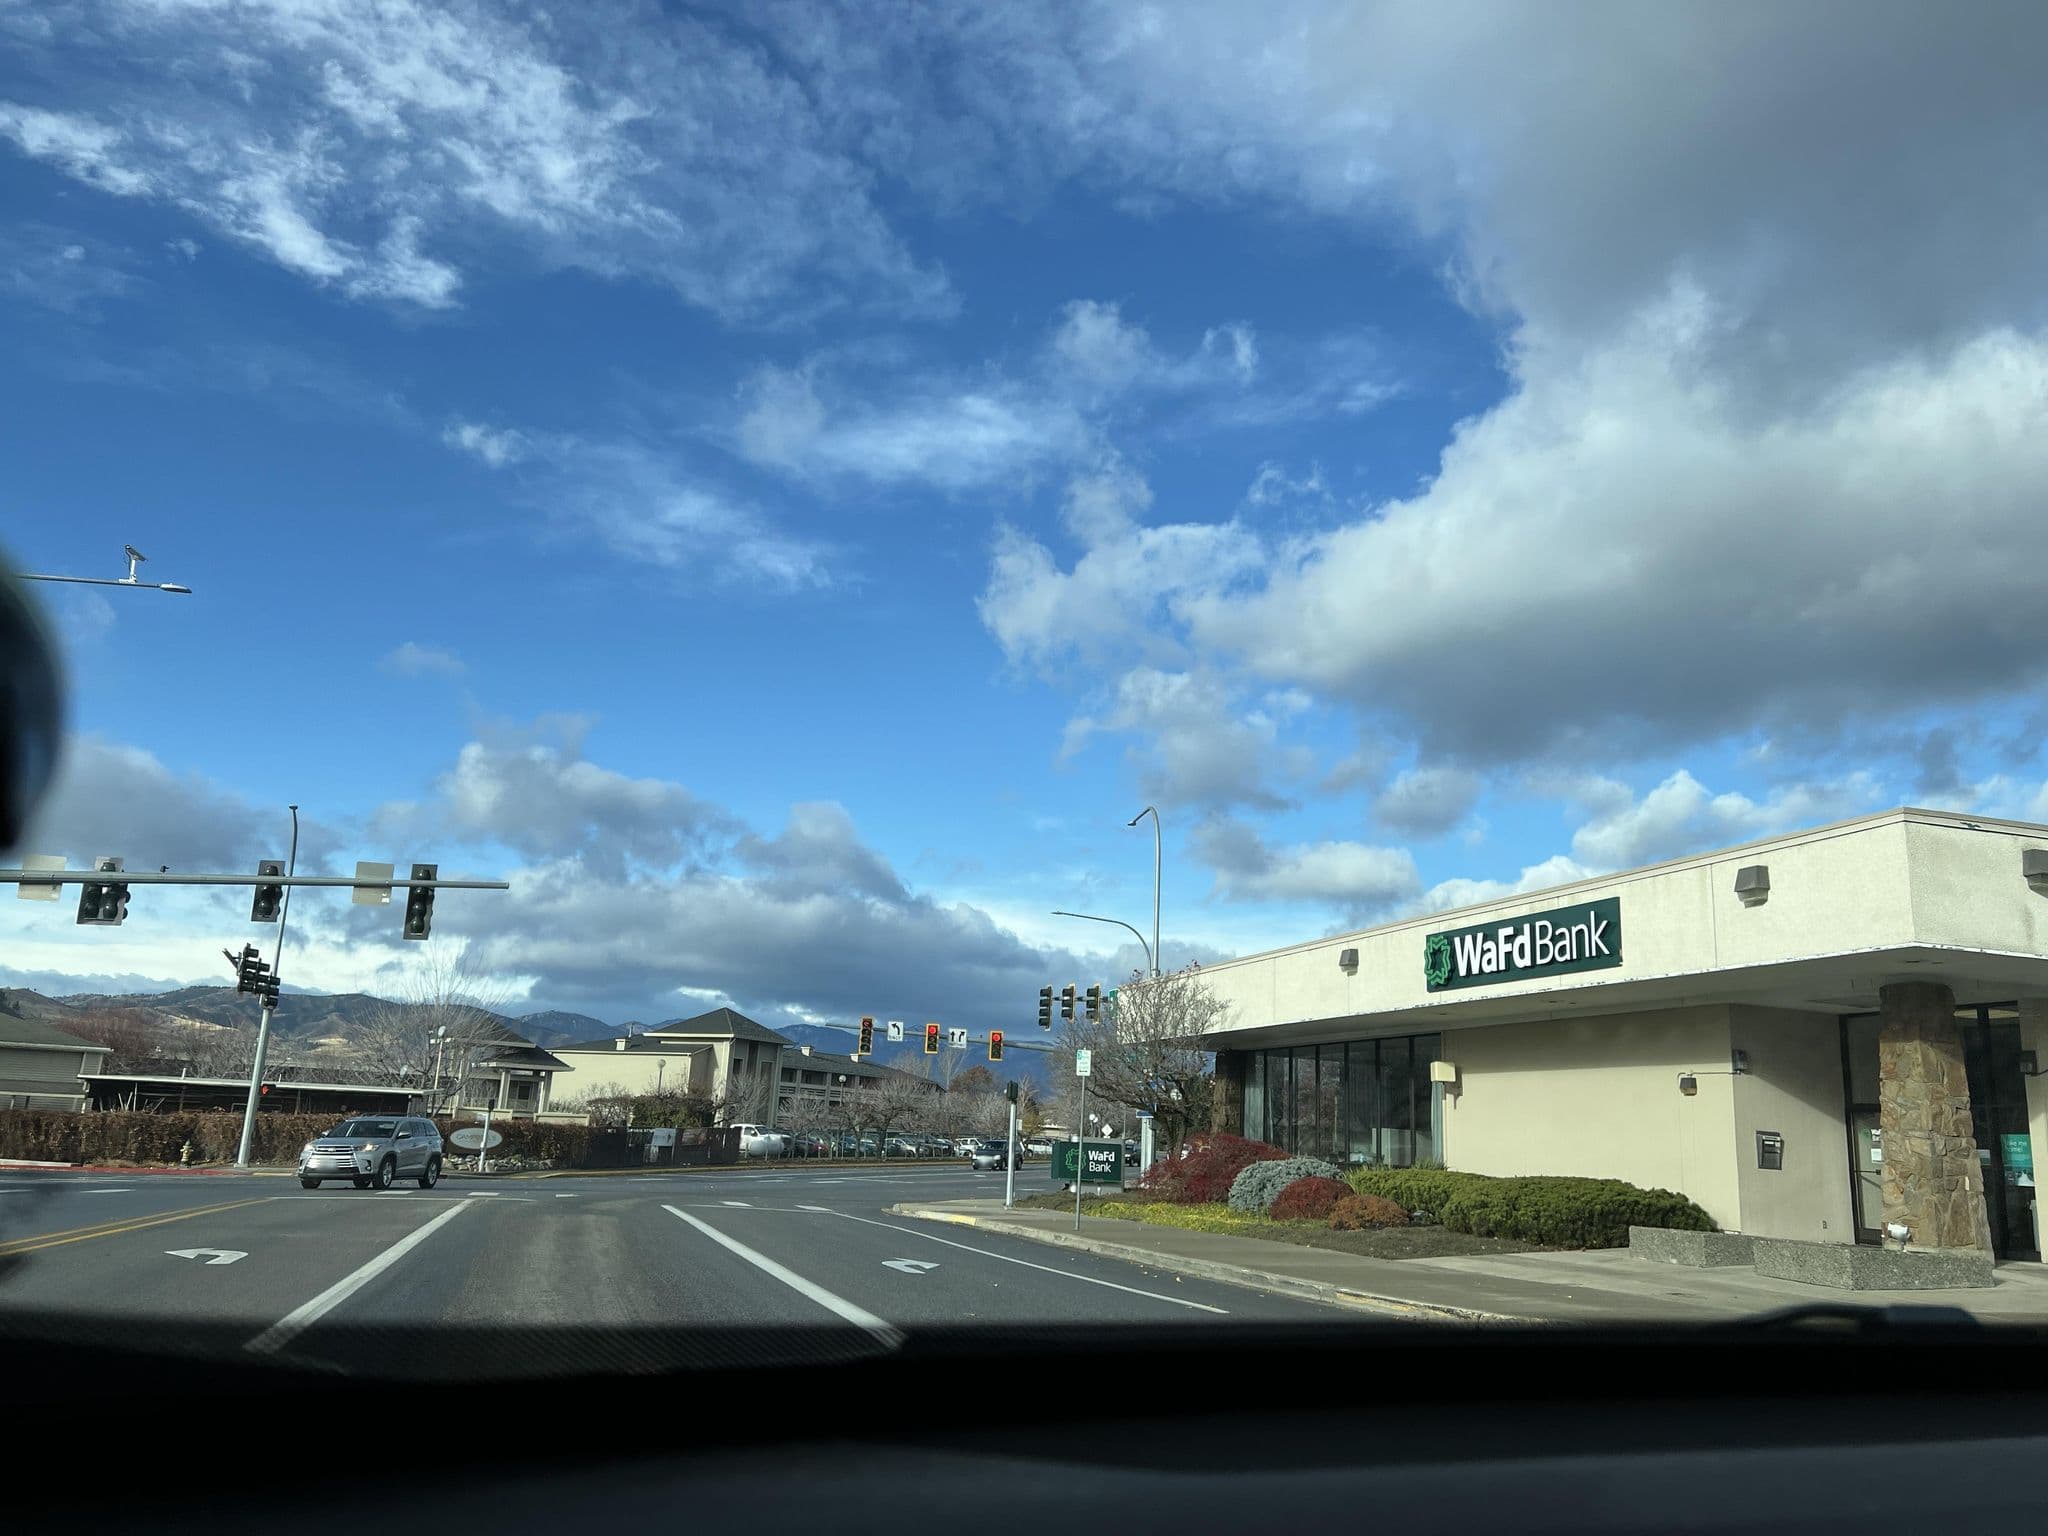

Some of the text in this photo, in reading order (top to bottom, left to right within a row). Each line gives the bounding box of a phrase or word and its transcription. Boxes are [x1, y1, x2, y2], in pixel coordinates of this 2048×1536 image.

[1453, 910, 1610, 977] WaFd Bank
[1088, 1150, 1115, 1162] WaFd
[1089, 1161, 1111, 1173] Bank
